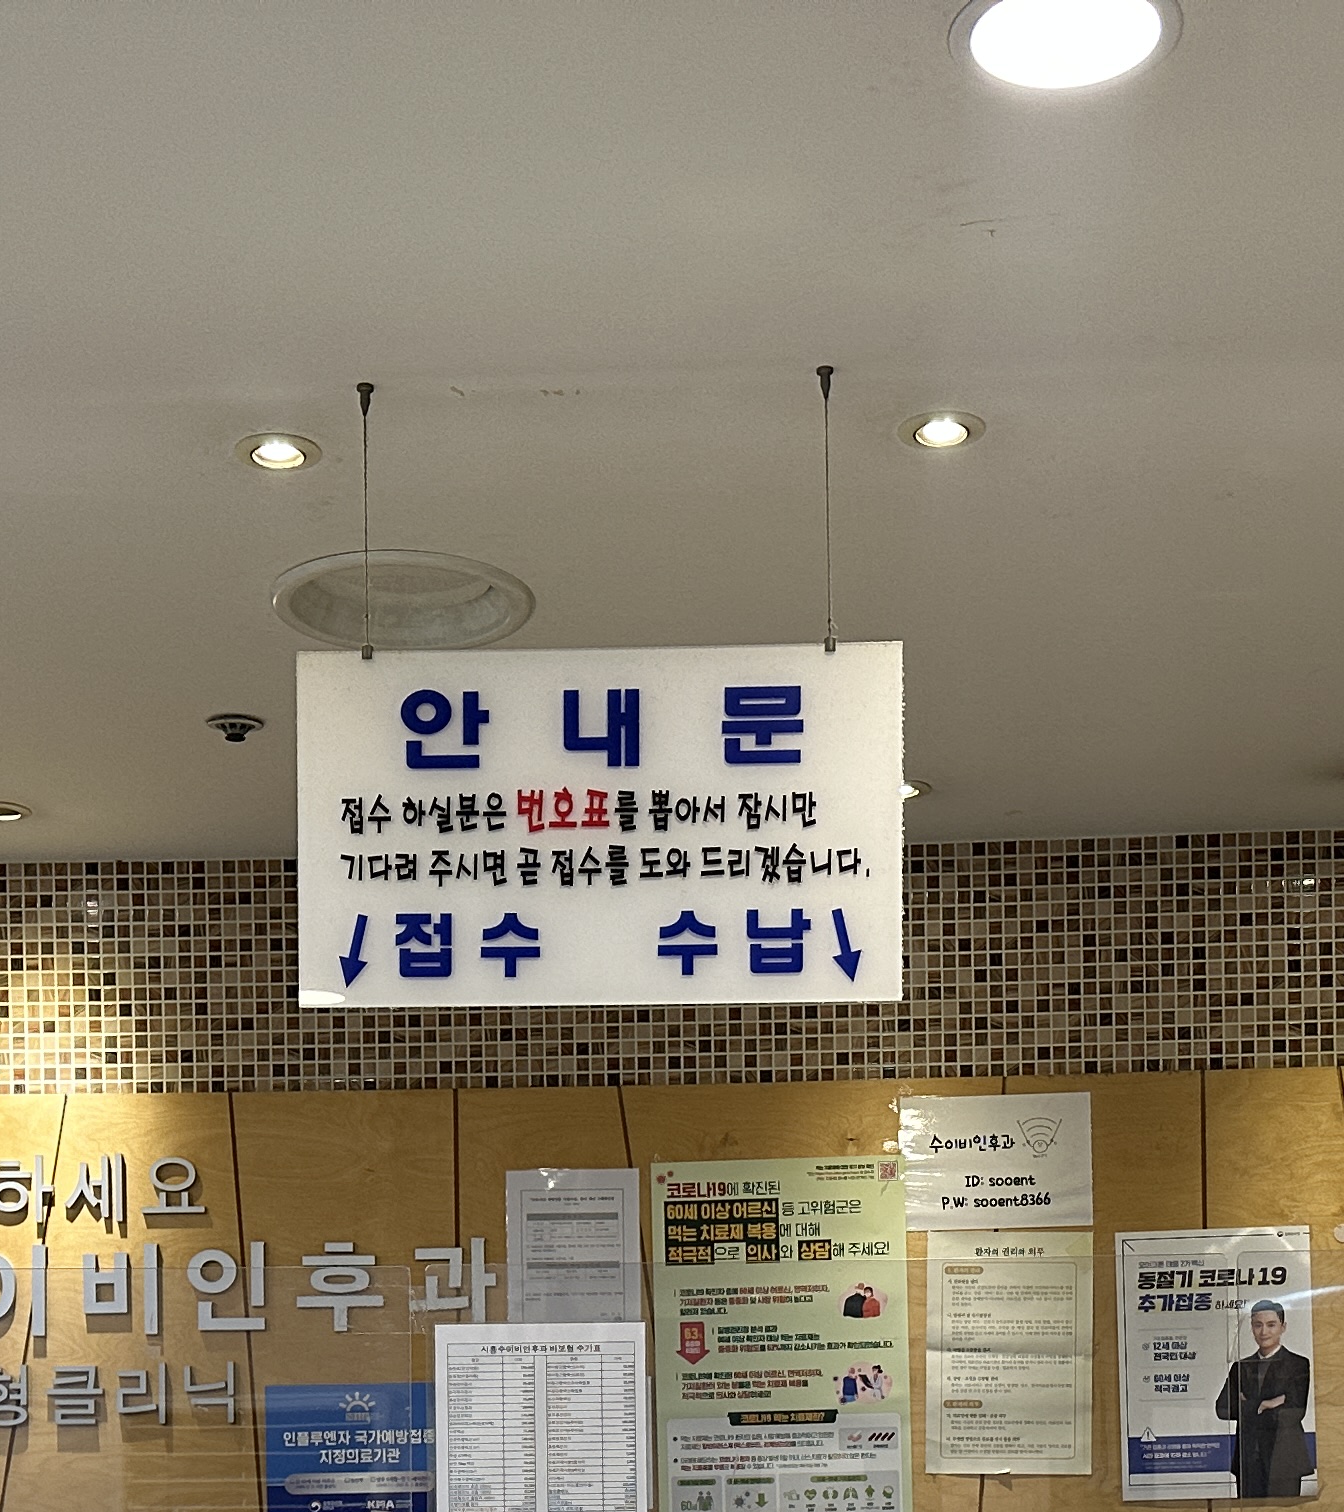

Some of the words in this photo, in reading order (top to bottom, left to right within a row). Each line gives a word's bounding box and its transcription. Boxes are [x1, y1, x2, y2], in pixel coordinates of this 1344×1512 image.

[341, 795, 392, 834] 접수
[403, 792, 508, 832] 하실분은
[649, 790, 726, 831] 뽑아서
[737, 791, 817, 832] 잠시만
[341, 850, 418, 883] 기다려
[429, 848, 506, 888] 주시면
[516, 849, 541, 883] 곧
[551, 845, 629, 887] 접수를
[640, 846, 690, 879] 도와
[700, 843, 871, 883] 드리겠습니다.
[394, 913, 541, 978] 접수
[657, 908, 811, 976] 수납
[929, 1134, 1015, 1153] 수이비인후과
[666, 1181, 739, 1198] 코로나19에
[743, 1181, 781, 1195] 확진된
[965, 1175, 984, 1187] ID:
[989, 1175, 1036, 1186] sooent
[974, 1192, 1051, 1208] sooent8366
[666, 1203, 697, 1220] 60세
[701, 1203, 730, 1219] 이상
[733, 1201, 777, 1218] 어르신
[782, 1202, 795, 1217] 등
[798, 1200, 861, 1216] 고위험군은
[667, 1226, 697, 1241] 먹는
[700, 1224, 744, 1241] 치료제
[747, 1223, 791, 1239] 복용에
[796, 1223, 820, 1237] 대해
[667, 1246, 740, 1262] 적극적으로
[747, 1244, 793, 1262] 의사와
[800, 1242, 845, 1260] 상담해
[848, 1242, 890, 1256] 주세요!
[1138, 1270, 1194, 1289] 동절기
[1199, 1268, 1255, 1286] 코로나
[1257, 1267, 1287, 1285] 19
[1138, 1293, 1212, 1312] 추가접종
[1215, 1300, 1247, 1309] 하세요!
[1180, 1352, 1196, 1360] 대상
[1174, 1374, 1189, 1382] 이상
[283, 1430, 351, 1446] 인플루엔자
[355, 1429, 435, 1445] 국가예방접종
[320, 1450, 400, 1464] 지정의료기관
